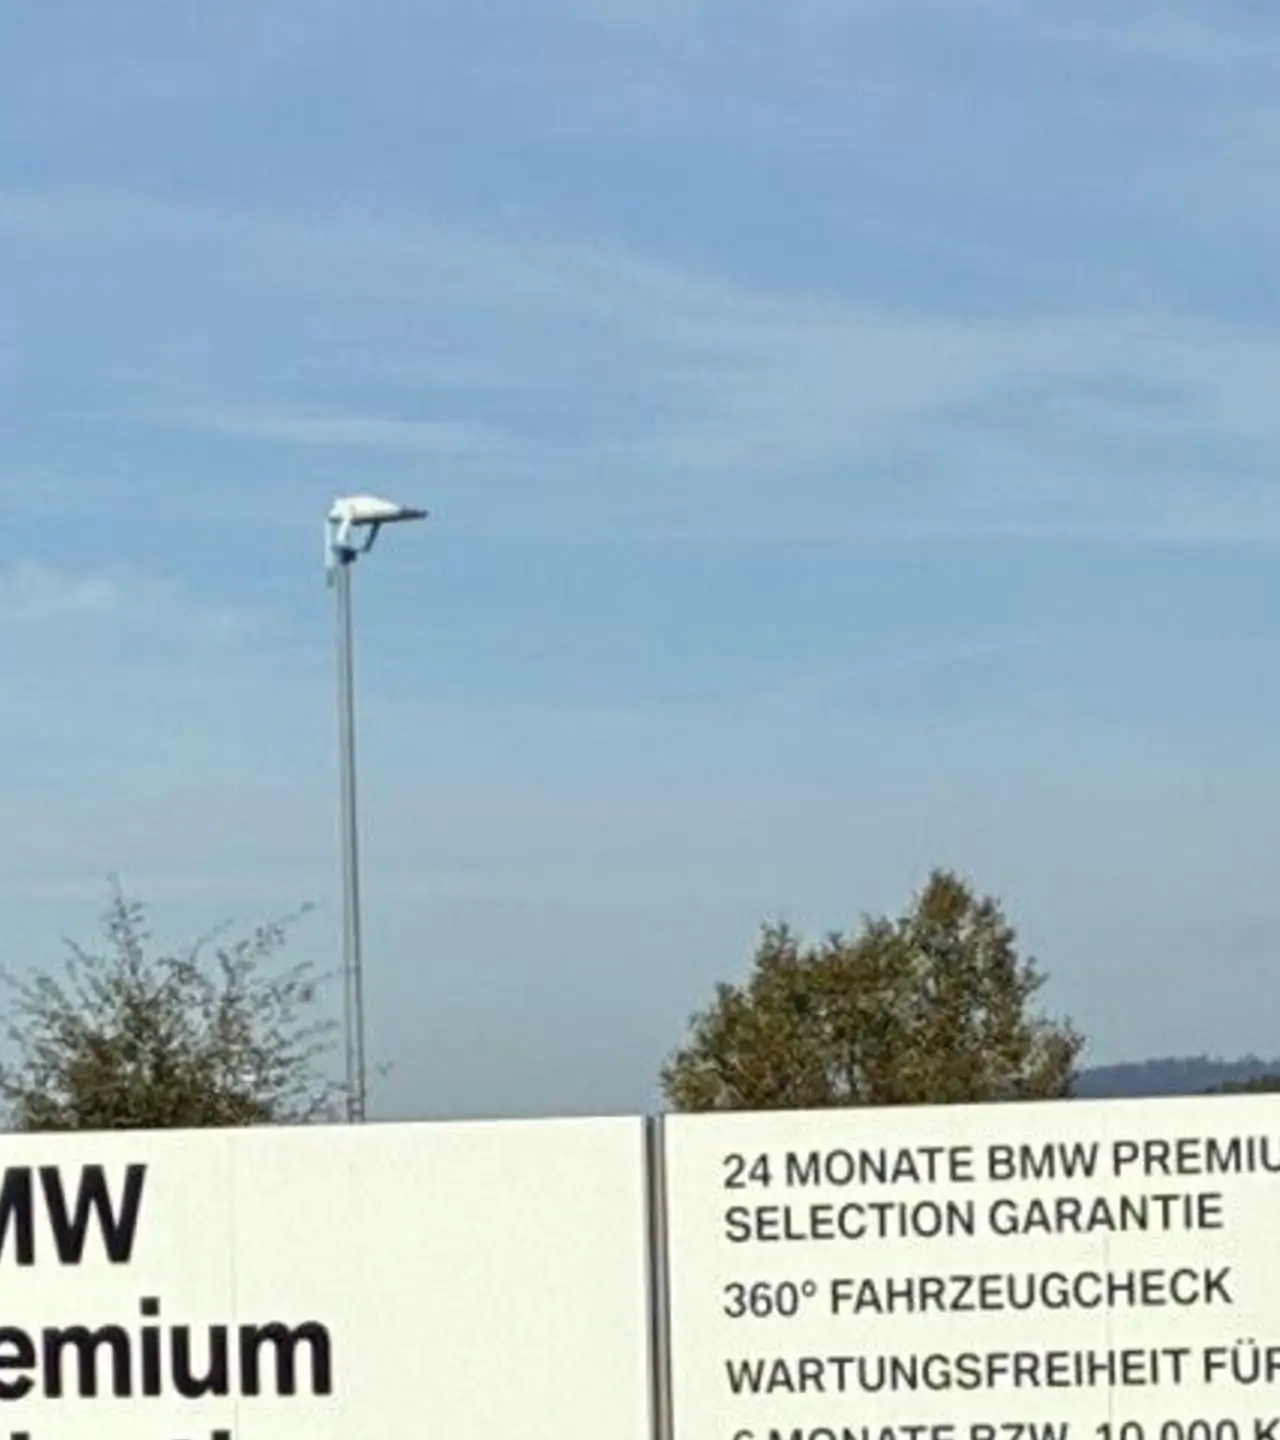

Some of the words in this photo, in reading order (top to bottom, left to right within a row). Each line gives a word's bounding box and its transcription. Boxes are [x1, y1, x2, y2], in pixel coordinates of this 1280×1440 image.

[723, 1153, 771, 1189] 24
[786, 1146, 974, 1186] MONATE
[988, 1142, 1098, 1181] BMW
[725, 1200, 974, 1243] SELECTION
[988, 1192, 1222, 1236] GARANTIE
[724, 1280, 816, 1318] 360°
[831, 1267, 1232, 1315] FAHRZEUGCHECK
[725, 1347, 1190, 1394] WARTUNGSFREIHEIT
